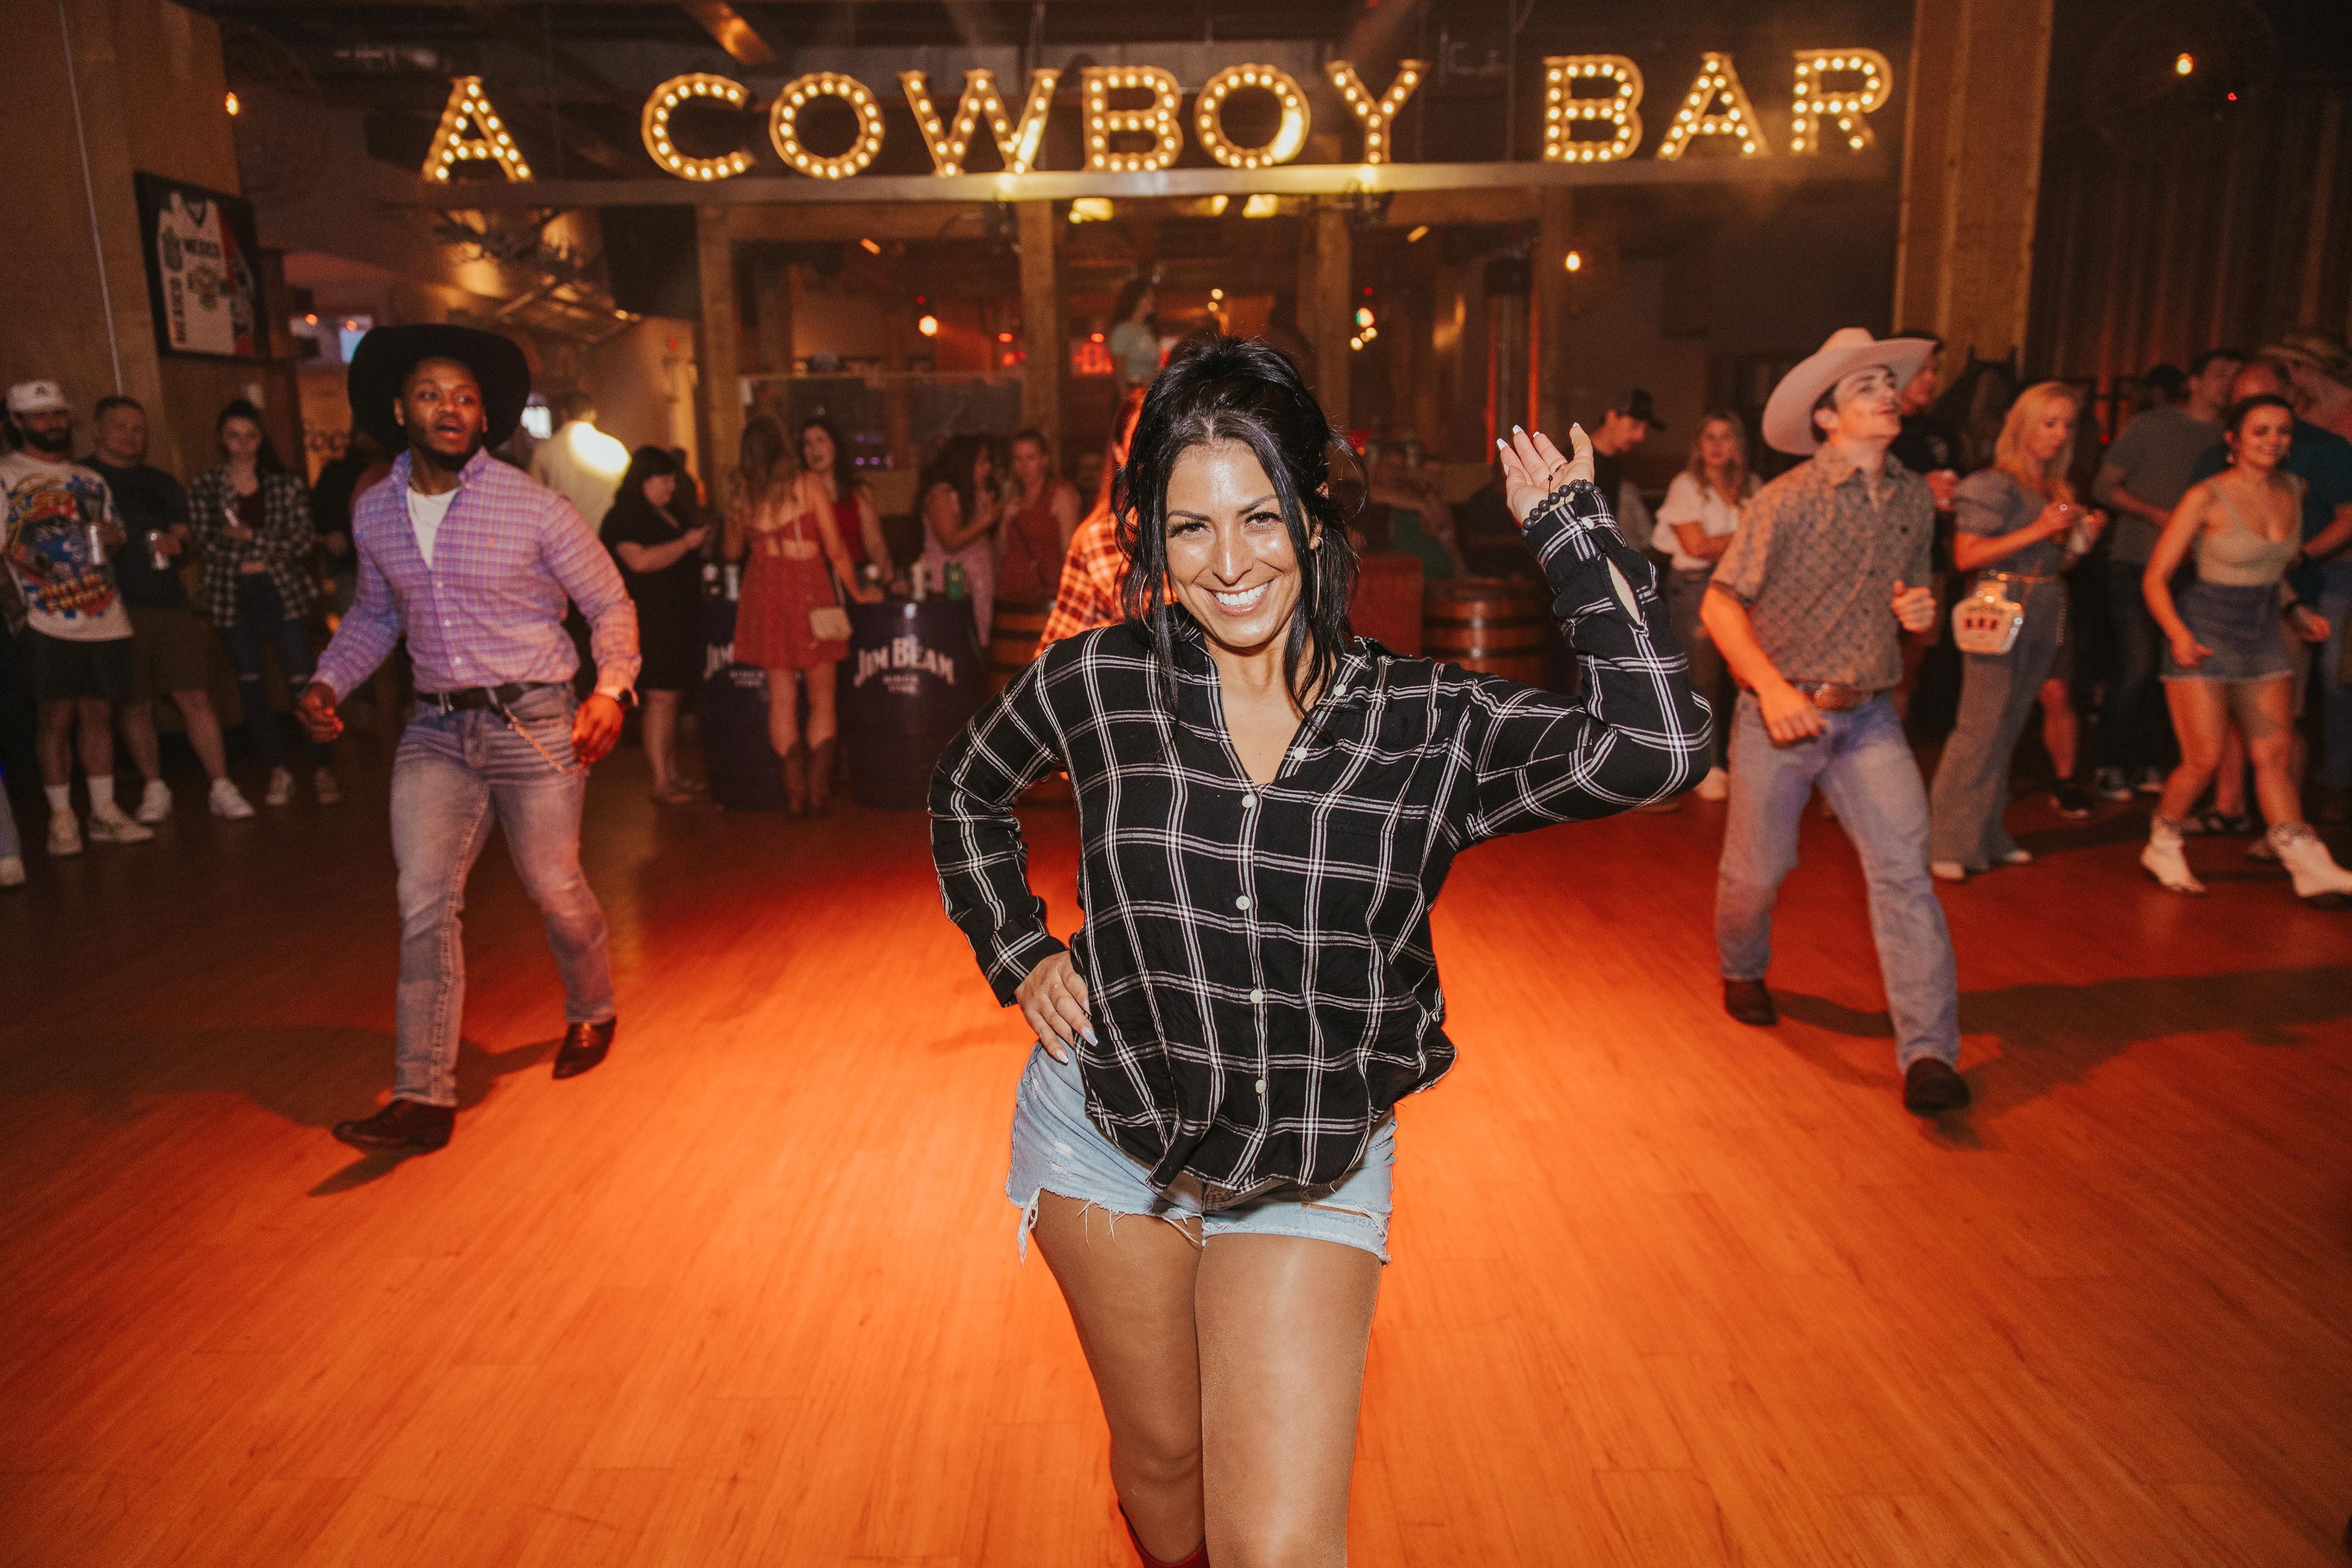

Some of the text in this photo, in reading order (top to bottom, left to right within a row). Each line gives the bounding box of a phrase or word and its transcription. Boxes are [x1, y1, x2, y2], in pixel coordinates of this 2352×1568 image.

[421, 48, 1893, 184] A COWBOY BAR
[853, 635, 955, 688] JIM BEAM
